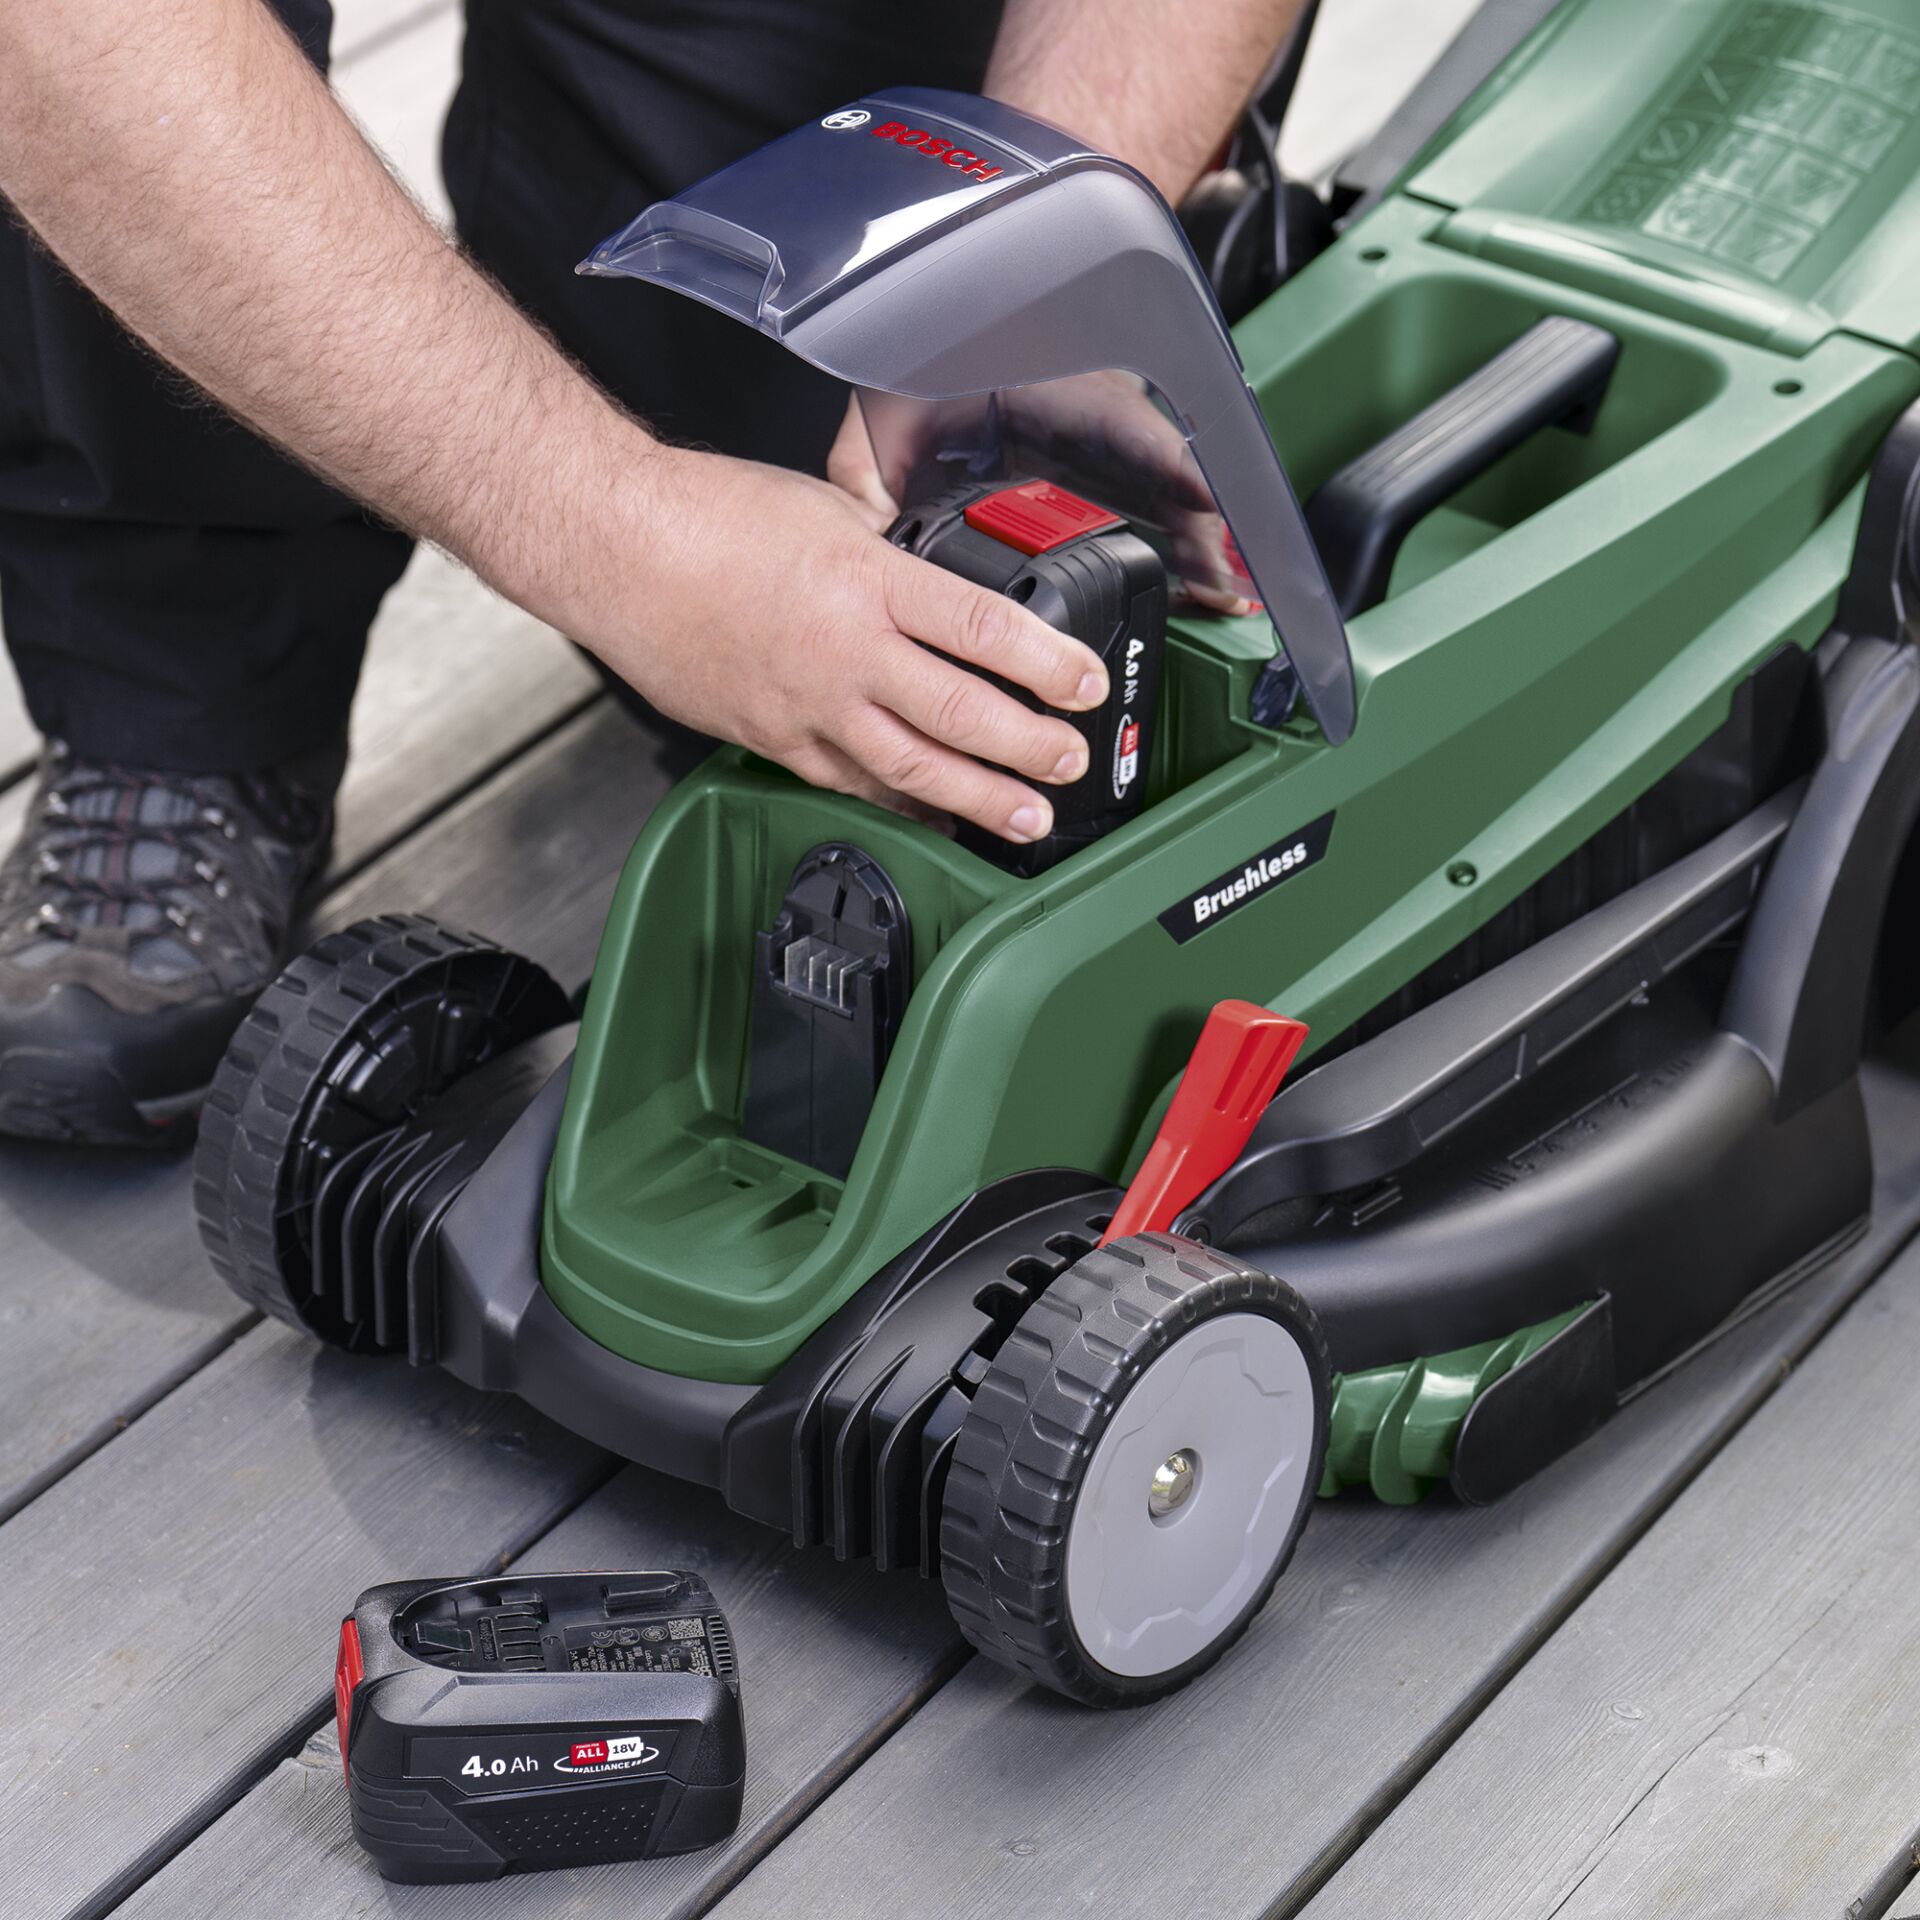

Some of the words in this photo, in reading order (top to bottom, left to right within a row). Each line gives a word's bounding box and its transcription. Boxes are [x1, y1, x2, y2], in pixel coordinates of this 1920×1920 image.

[871, 121, 1004, 183] BOSCH
[1125, 637, 1144, 677] 4.0
[1123, 679, 1138, 705] Ah
[1193, 842, 1308, 923] Brushless
[577, 1747, 604, 1759] ALL
[613, 1742, 637, 1755] 18V
[461, 1755, 507, 1778] 4.0
[510, 1756, 539, 1774] Ah
[583, 1761, 631, 1774] ALLIANCE
